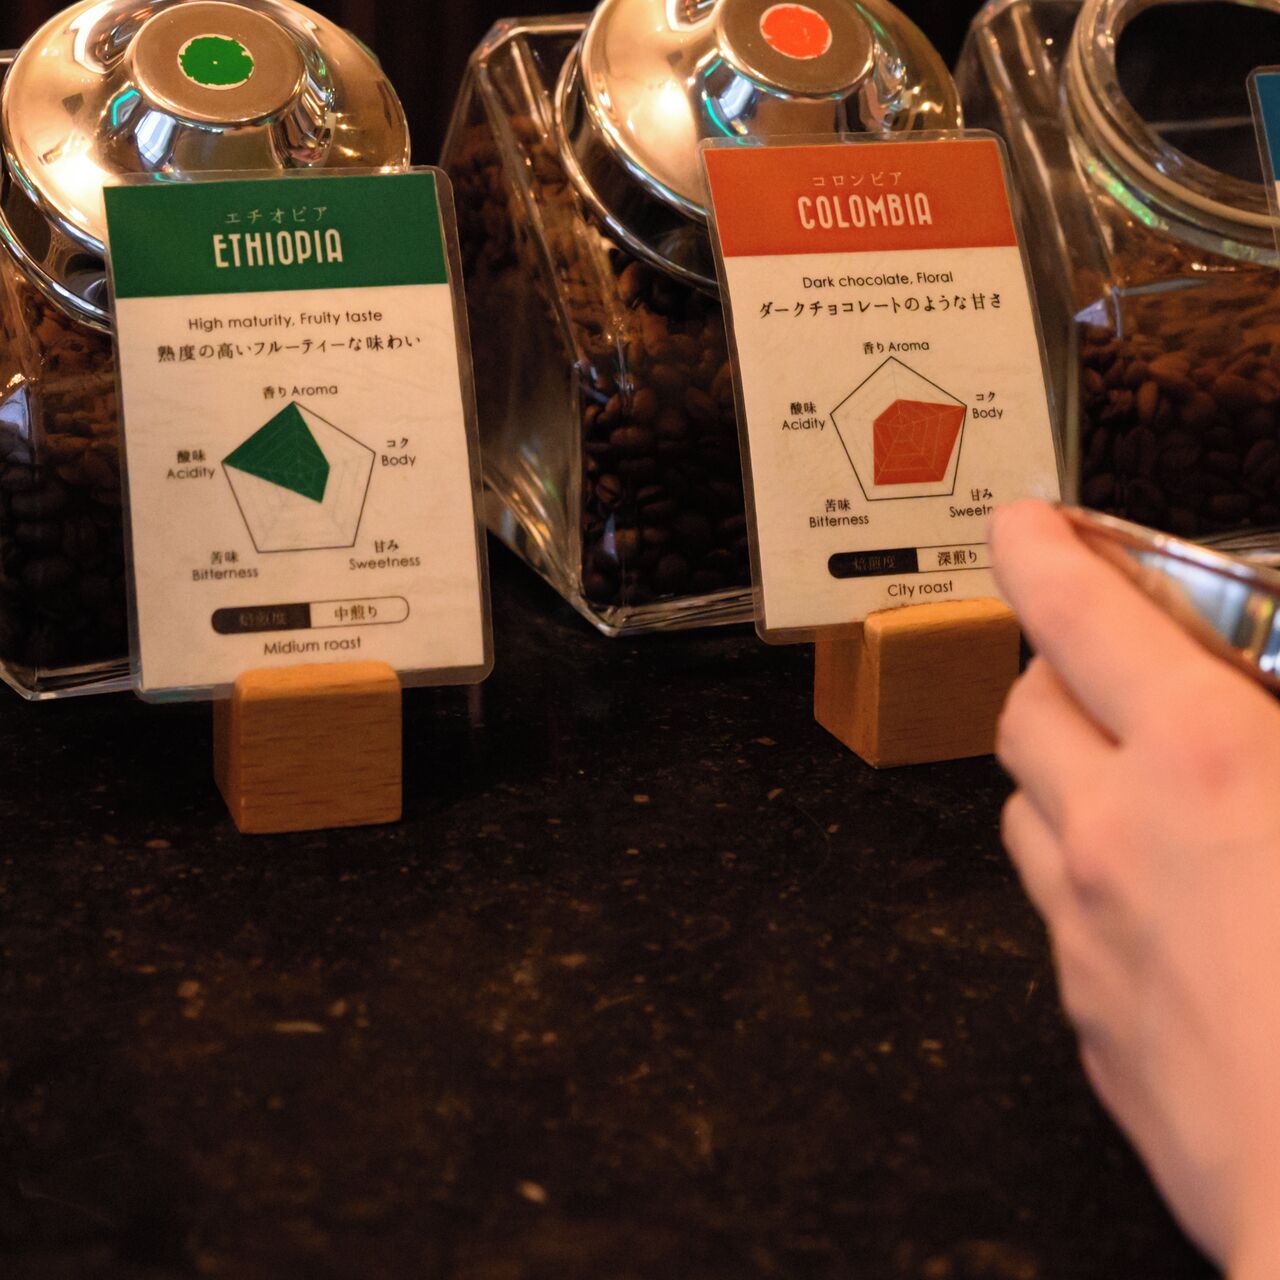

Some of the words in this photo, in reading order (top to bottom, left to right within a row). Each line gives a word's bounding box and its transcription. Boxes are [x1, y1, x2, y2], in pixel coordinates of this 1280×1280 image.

[225, 206, 327, 225] エチオピア
[797, 192, 933, 230] COLOMBIA
[212, 228, 343, 268] ETHIOPIA
[802, 276, 835, 289] Dark
[839, 273, 913, 287] chocolate,
[917, 271, 954, 284] Floral
[760, 292, 1002, 319] ダークチョコレートのような甘さ
[188, 316, 223, 333] High
[228, 313, 296, 330] maturity,
[300, 311, 341, 327] Fruity
[345, 309, 382, 323] taste
[157, 334, 421, 363] 熟度の高いフルーティーな味わい
[863, 341, 884, 355] 香り
[888, 340, 930, 352] Aroma
[263, 386, 287, 400] 香り
[291, 384, 338, 397] Aroma
[975, 391, 996, 402] コク
[790, 401, 817, 415] 酸味
[972, 407, 1003, 420] Body
[782, 418, 826, 431] Acidity
[386, 437, 409, 449] コク
[177, 449, 206, 464] 酸味
[381, 454, 416, 468] Body
[166, 468, 215, 480] Acidity
[970, 489, 993, 502] 甘み
[825, 499, 851, 512] 苦味
[809, 514, 869, 528] Bitterness
[374, 539, 400, 553] 甘み
[349, 556, 421, 571] Sweetness
[937, 550, 978, 566] 深煎り
[192, 568, 259, 582] Bitterness
[888, 583, 914, 597] City
[919, 580, 953, 594] roast
[334, 605, 378, 621] 中煎り
[263, 639, 320, 655] Midium
[324, 637, 361, 651] roast
